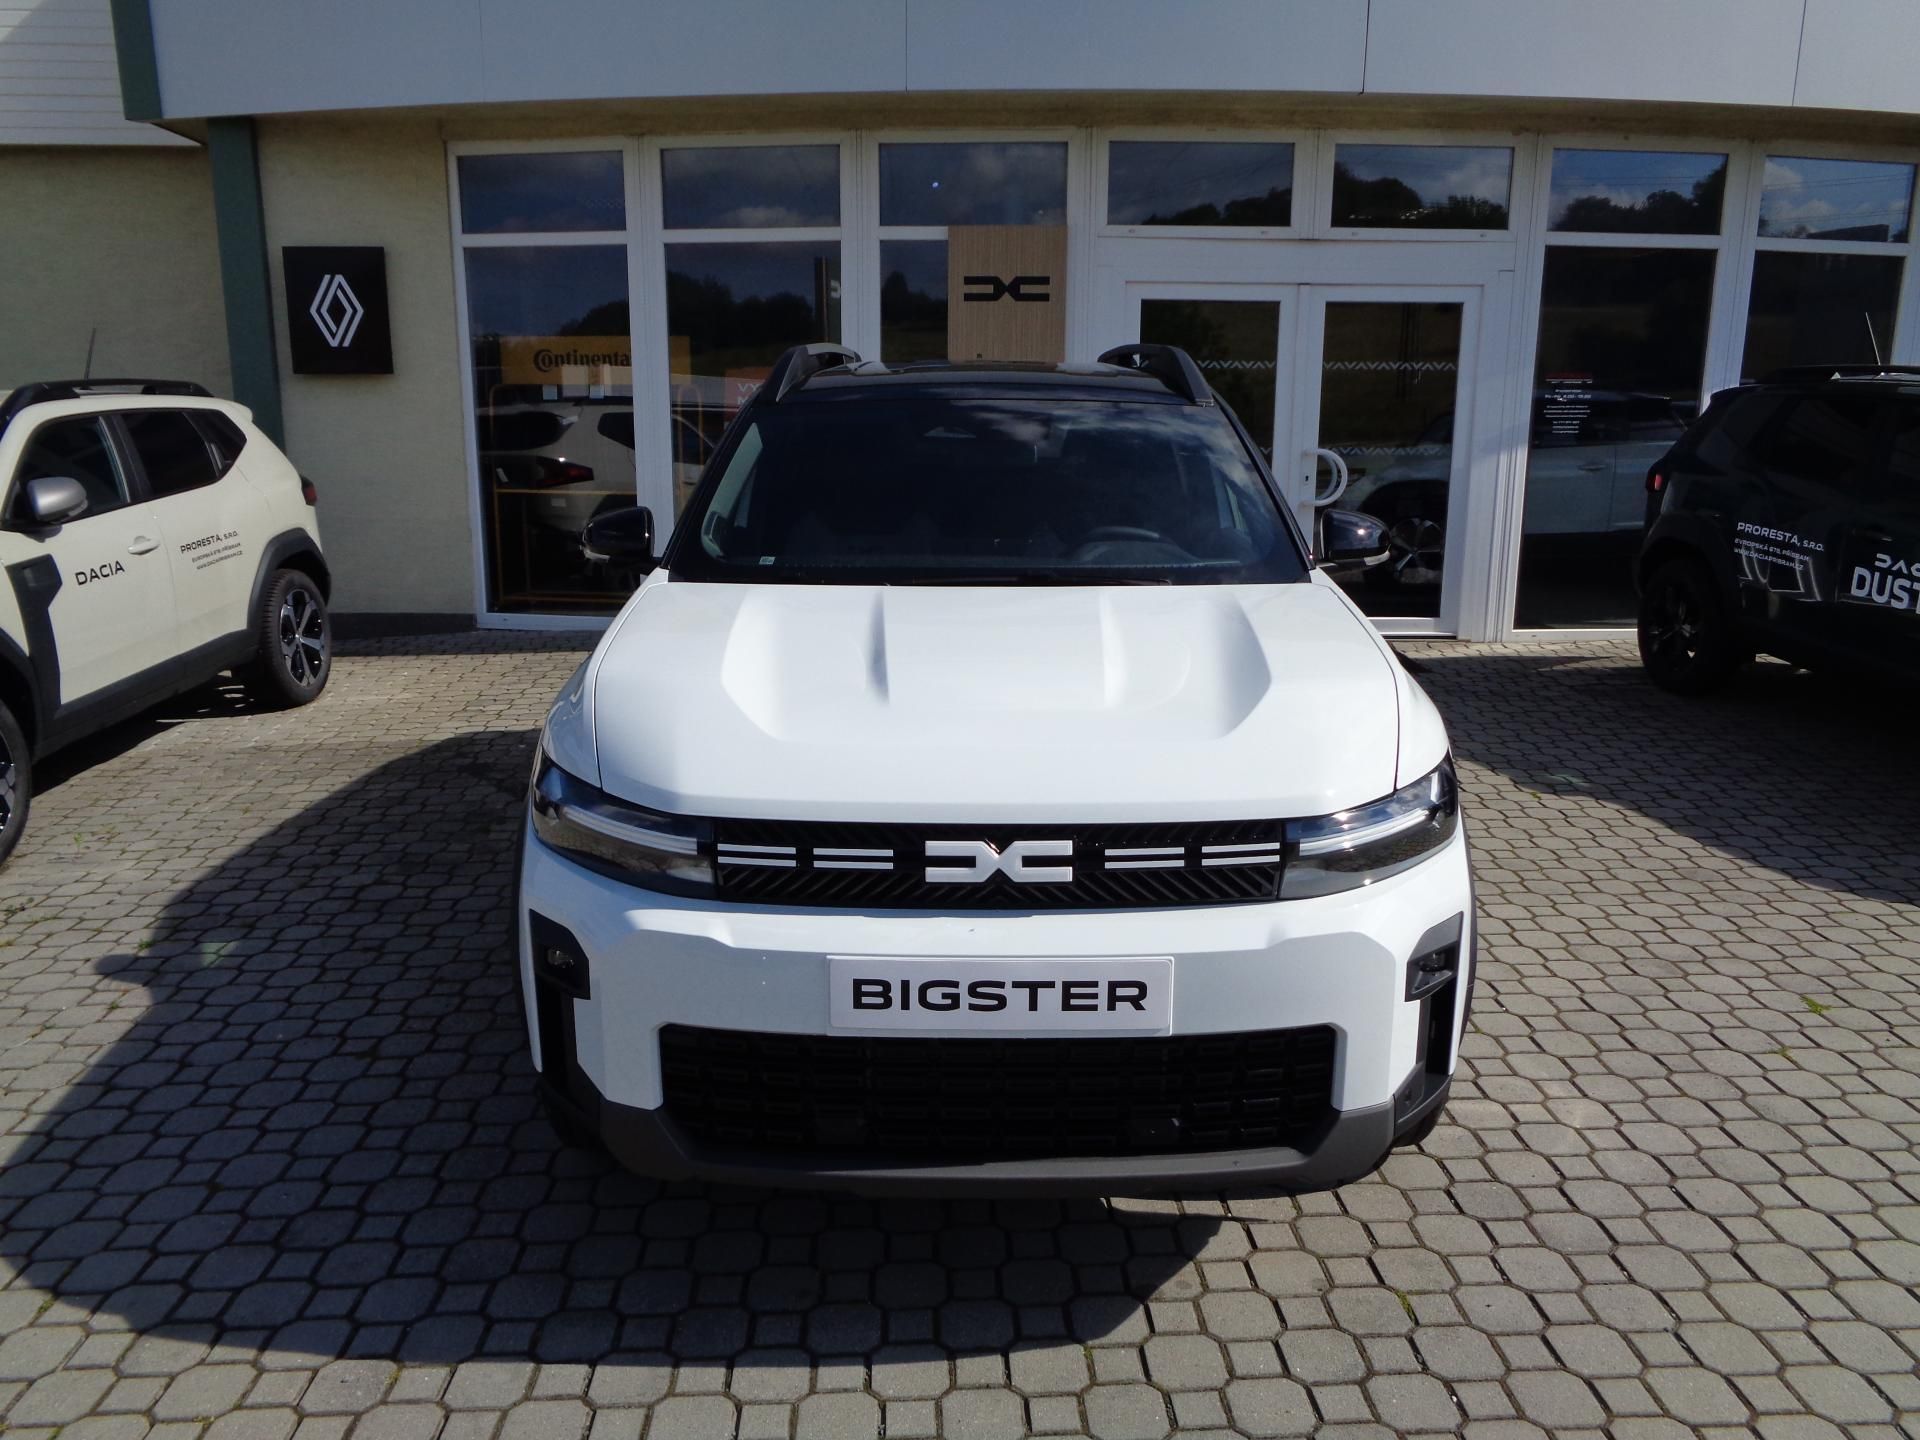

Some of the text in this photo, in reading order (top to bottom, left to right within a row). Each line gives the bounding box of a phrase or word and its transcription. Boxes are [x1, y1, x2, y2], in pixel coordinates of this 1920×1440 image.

[533, 349, 630, 372] Continenta
[180, 534, 223, 554] PRORESTA,
[1737, 522, 1825, 552] PRORESTA, S.R.O.
[75, 560, 125, 586] DACIA
[852, 978, 1147, 1012] BIGSTER
